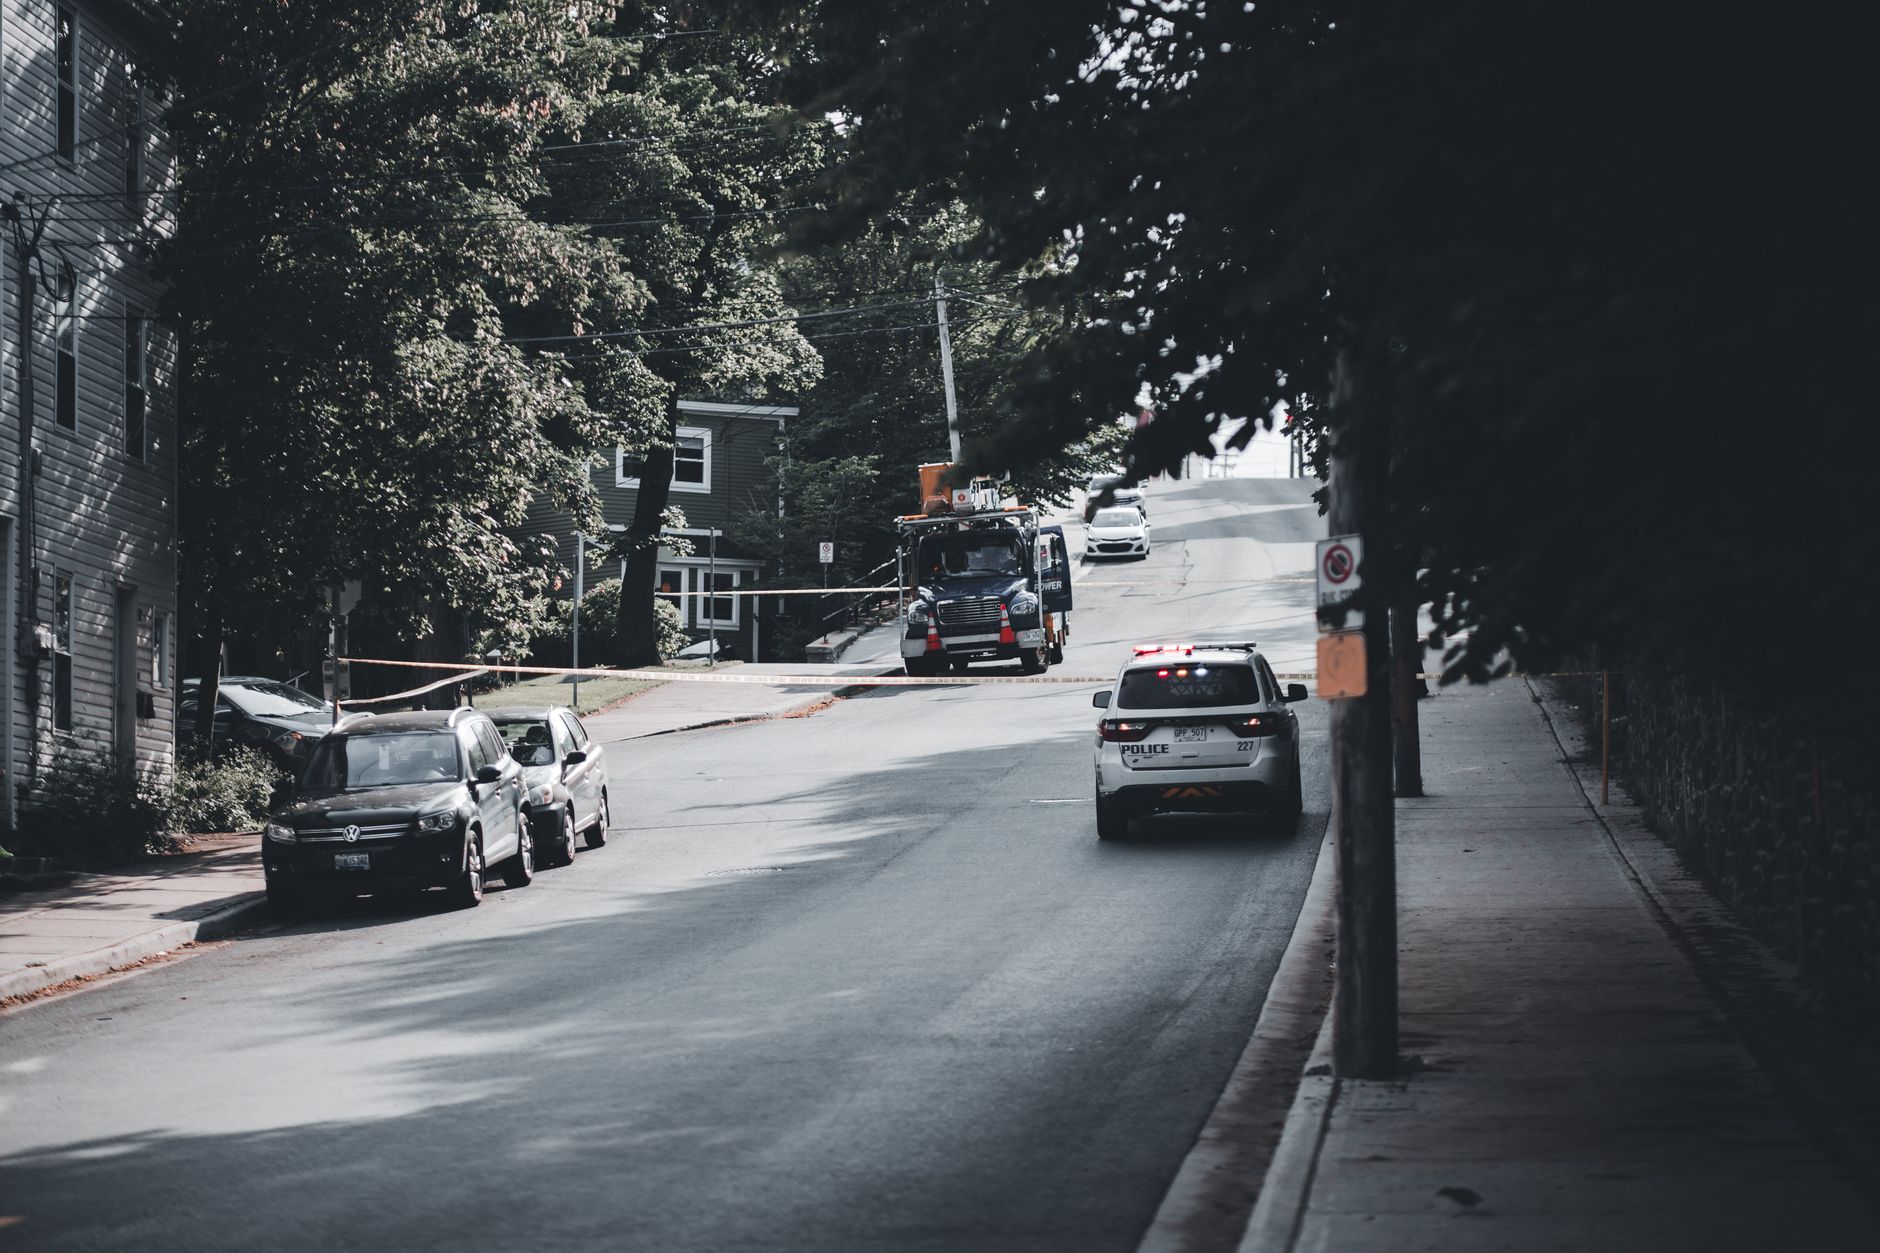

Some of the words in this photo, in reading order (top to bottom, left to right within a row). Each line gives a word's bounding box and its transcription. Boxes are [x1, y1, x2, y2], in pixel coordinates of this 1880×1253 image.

[1034, 581, 1062, 592] POWER
[1191, 727, 1204, 737] 507
[1121, 744, 1169, 754] POLICE
[1237, 741, 1254, 751] 227
